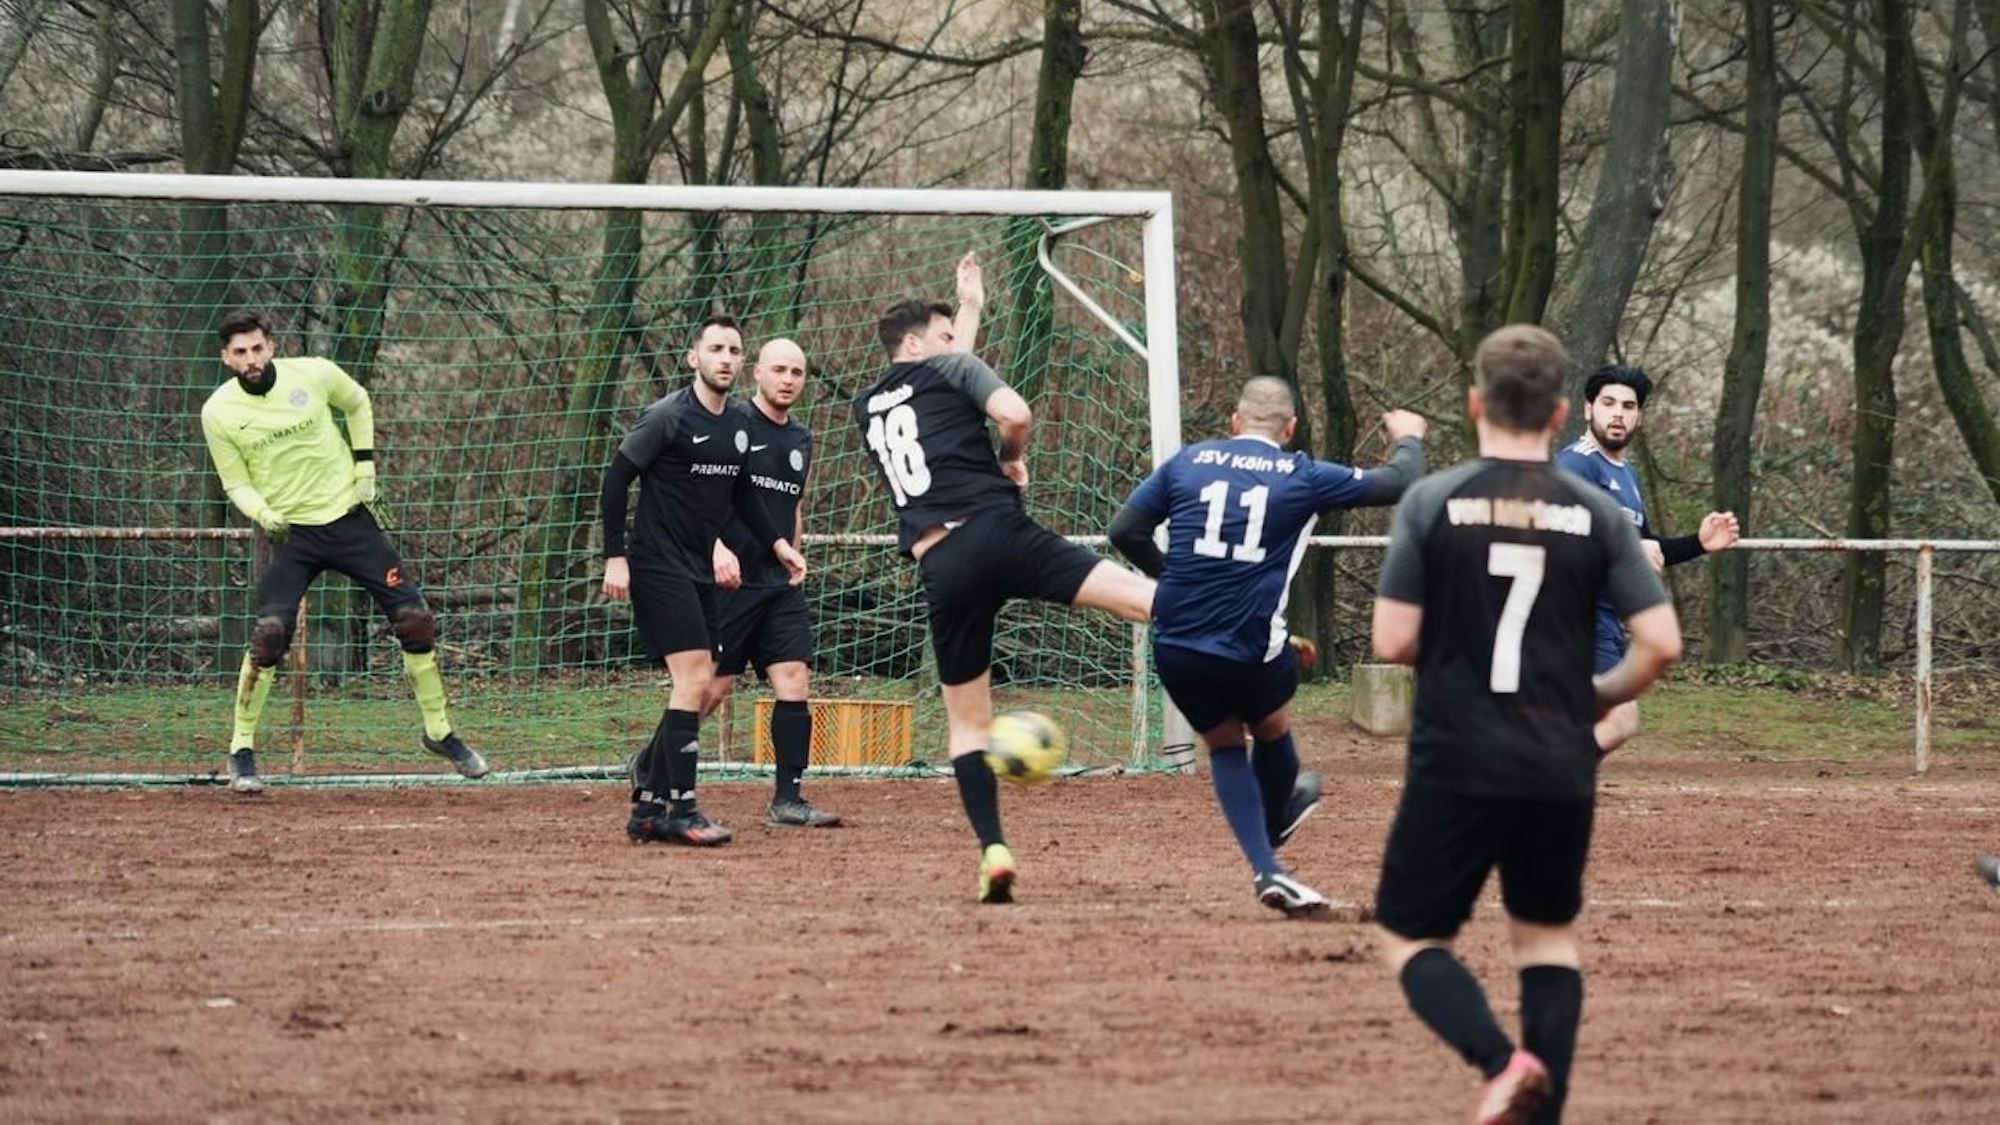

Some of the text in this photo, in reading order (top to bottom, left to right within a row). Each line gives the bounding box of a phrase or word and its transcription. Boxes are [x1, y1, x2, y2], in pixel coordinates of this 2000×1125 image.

[690, 463, 740, 477] PREMATC
[866, 403, 932, 507] 18
[1192, 449, 1295, 475] JSV Köln 96
[1193, 480, 1269, 563] 11
[1487, 542, 1546, 693] 7
